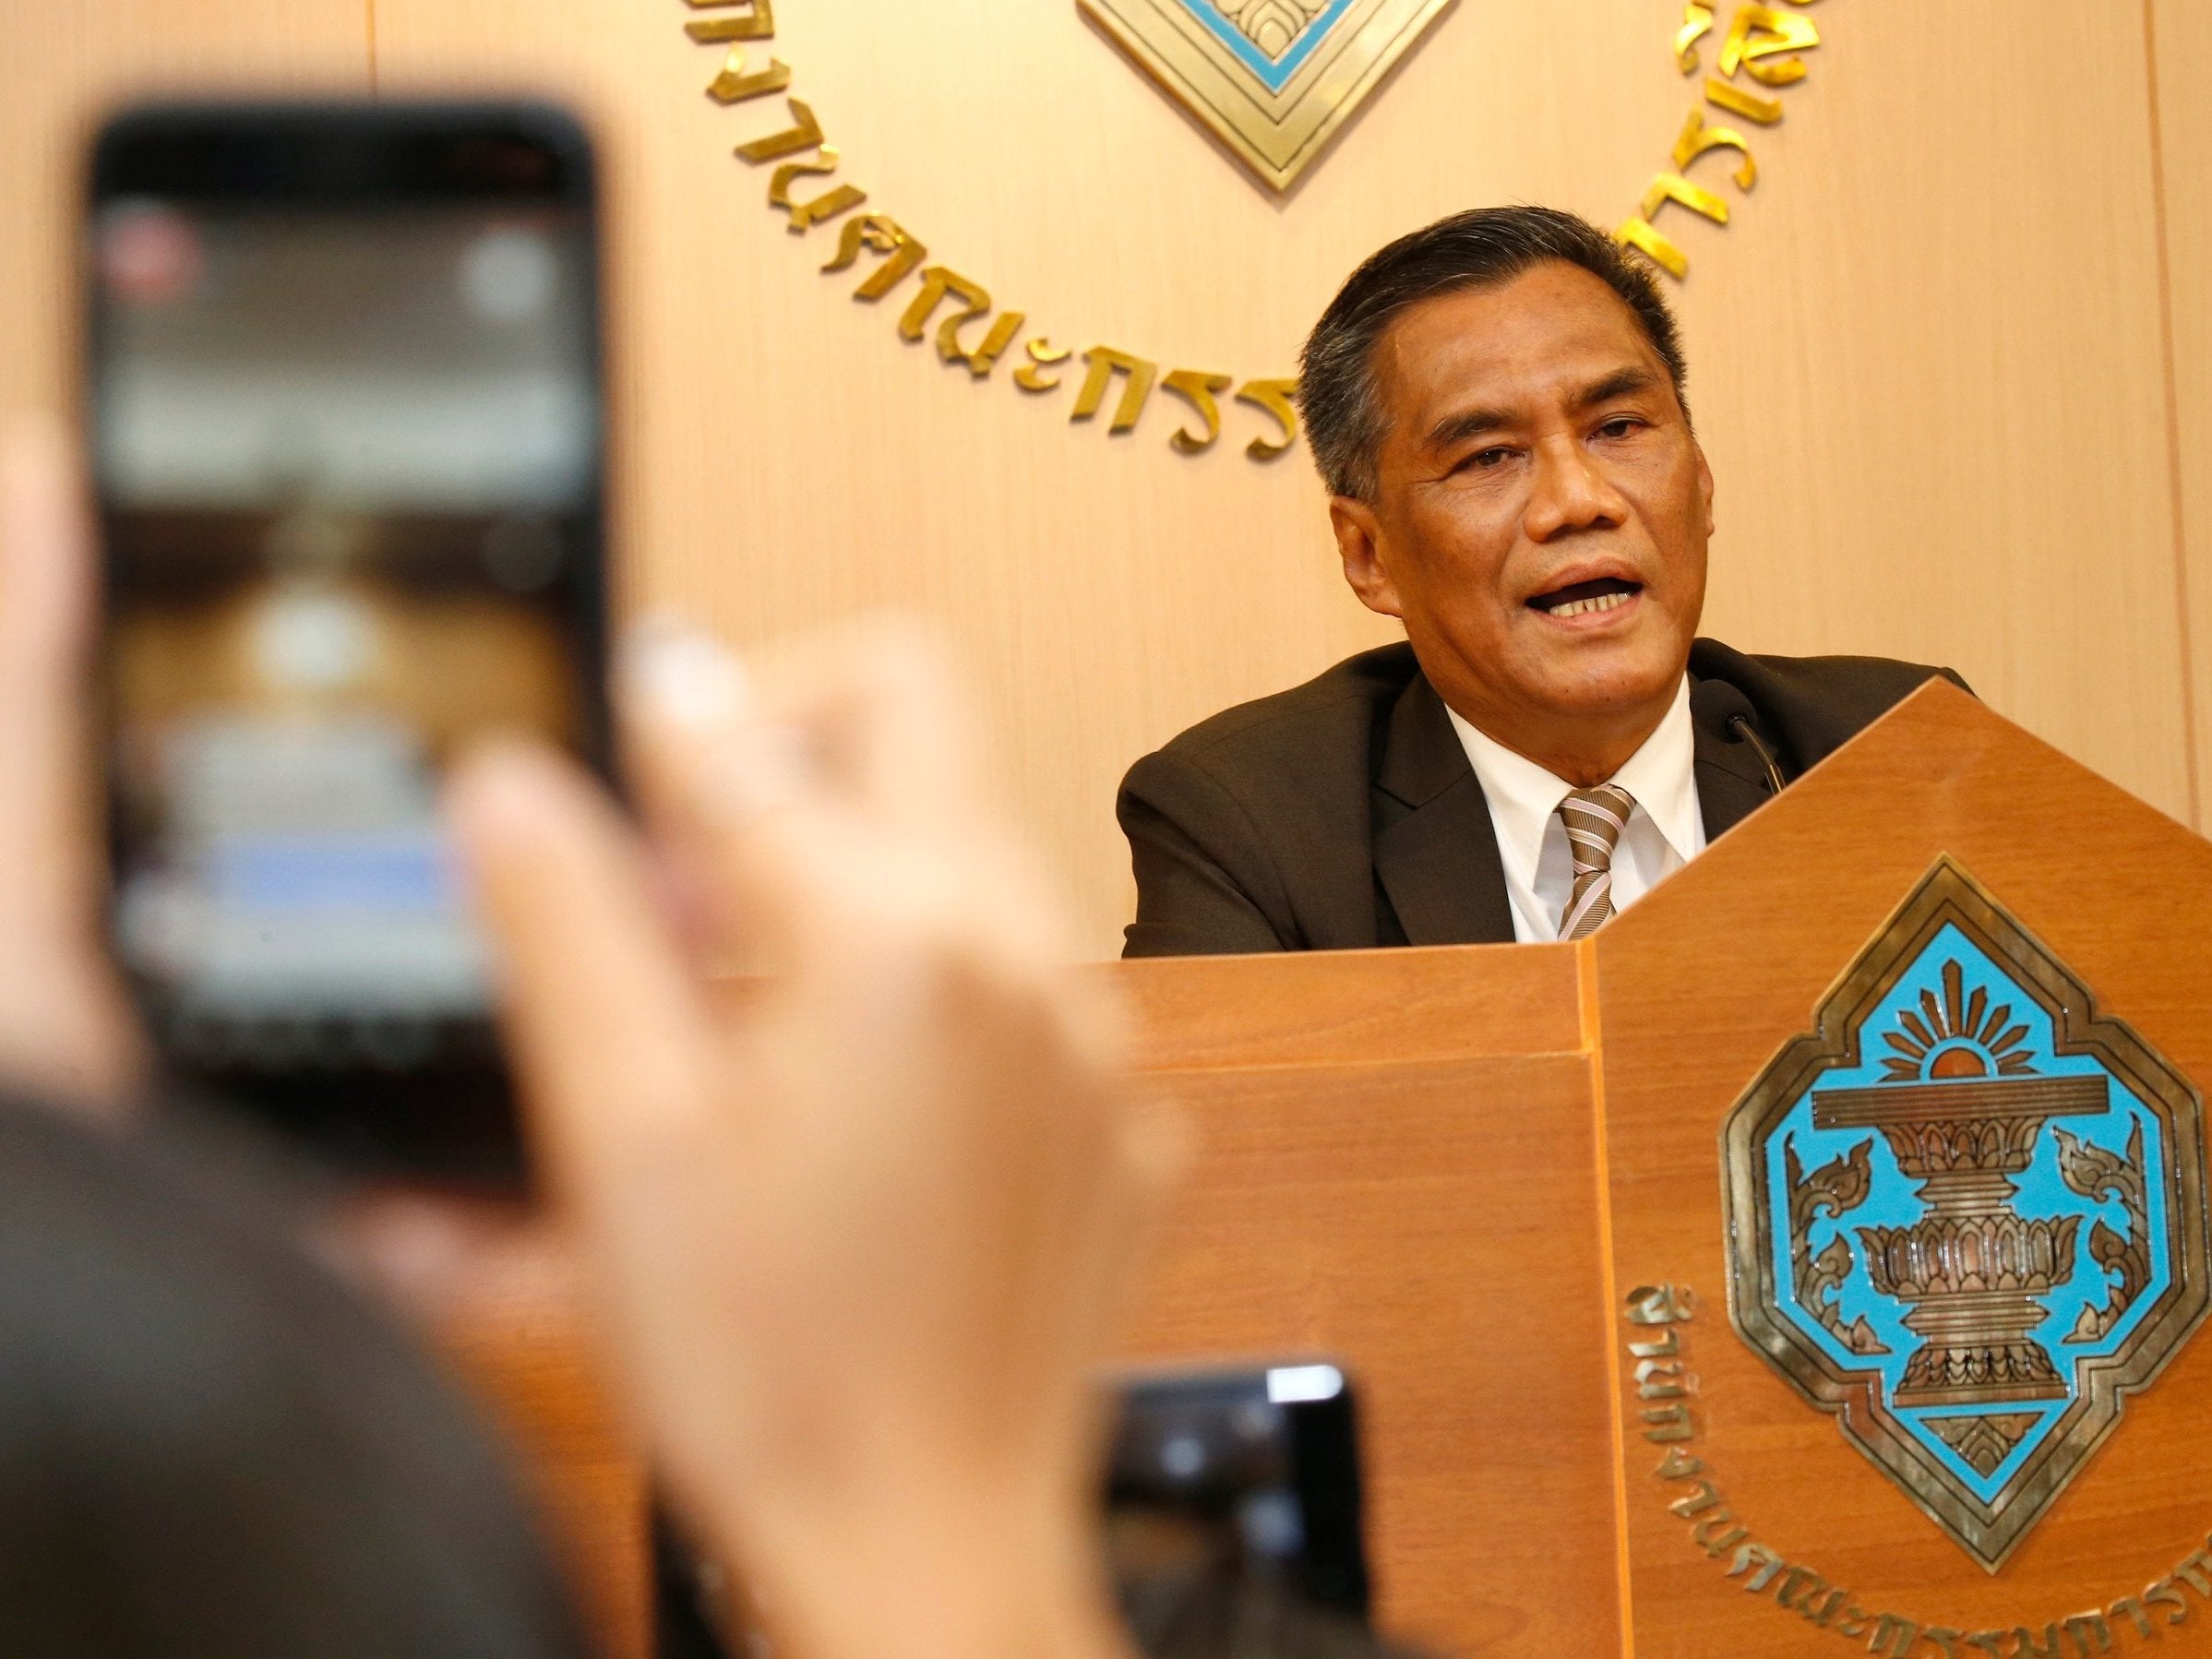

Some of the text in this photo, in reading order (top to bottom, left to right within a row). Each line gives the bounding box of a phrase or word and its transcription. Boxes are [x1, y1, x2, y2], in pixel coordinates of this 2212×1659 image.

[1624, 1283, 2212, 1659] สำนักงานคณะกรรมการก
